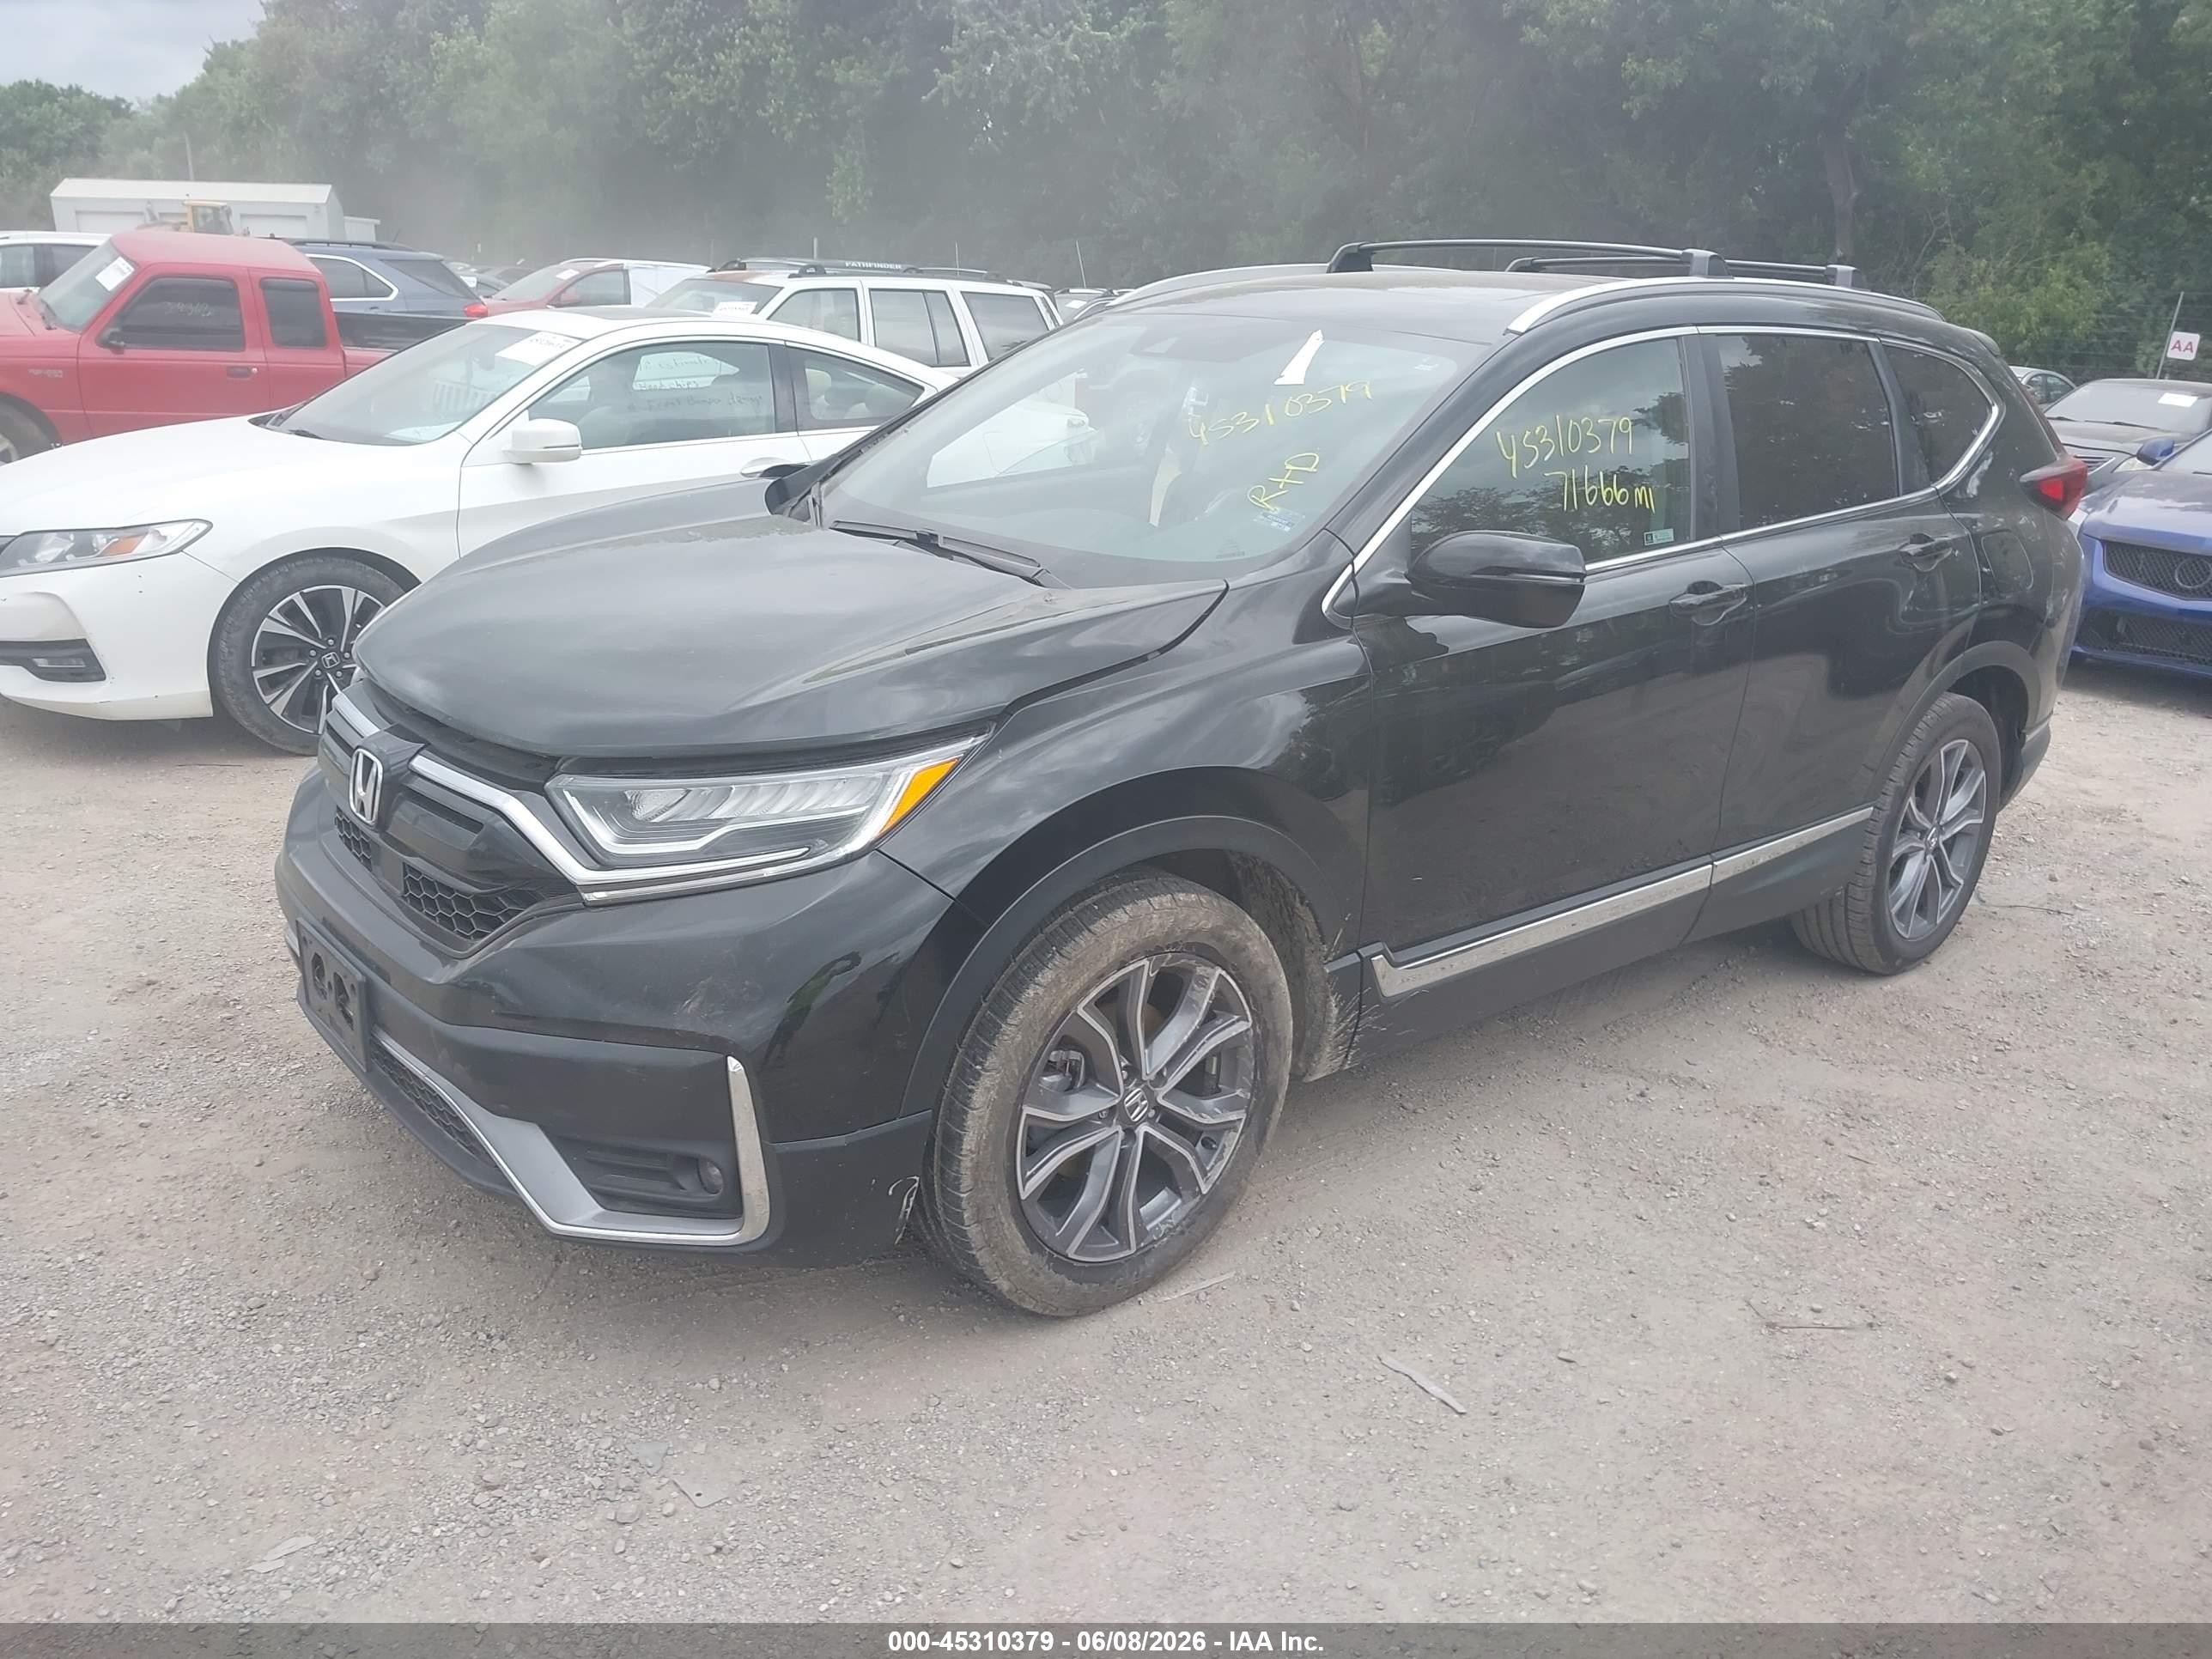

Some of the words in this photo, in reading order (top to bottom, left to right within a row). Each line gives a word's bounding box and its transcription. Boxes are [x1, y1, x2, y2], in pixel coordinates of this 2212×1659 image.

[1188, 380, 1373, 446] 45310379
[1496, 415, 1633, 479] 45310379
[1544, 465, 1629, 512] 71666
